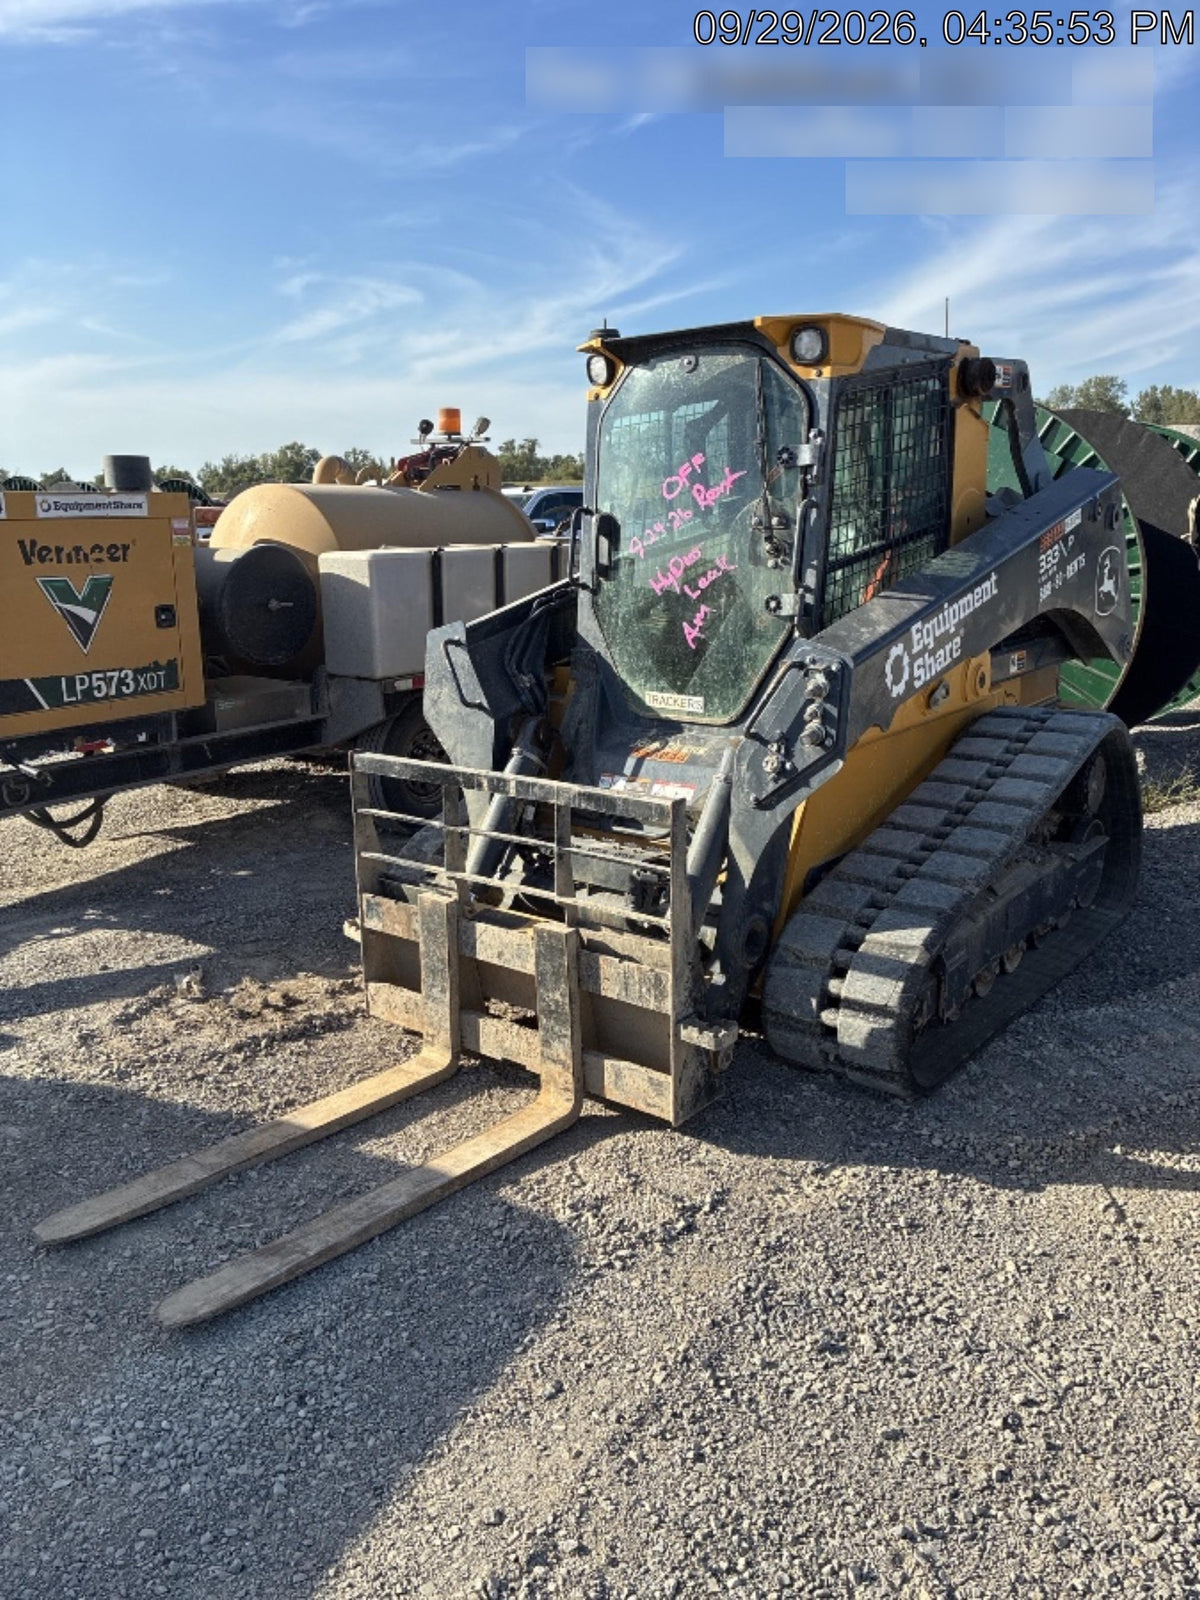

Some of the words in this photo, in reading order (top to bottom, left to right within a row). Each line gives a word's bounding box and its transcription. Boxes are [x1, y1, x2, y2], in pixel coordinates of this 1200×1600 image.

[17, 538, 131, 566] Vermeer
[911, 571, 998, 655] Equipment
[912, 635, 962, 689] Share
[646, 692, 704, 711] TRACKERS
